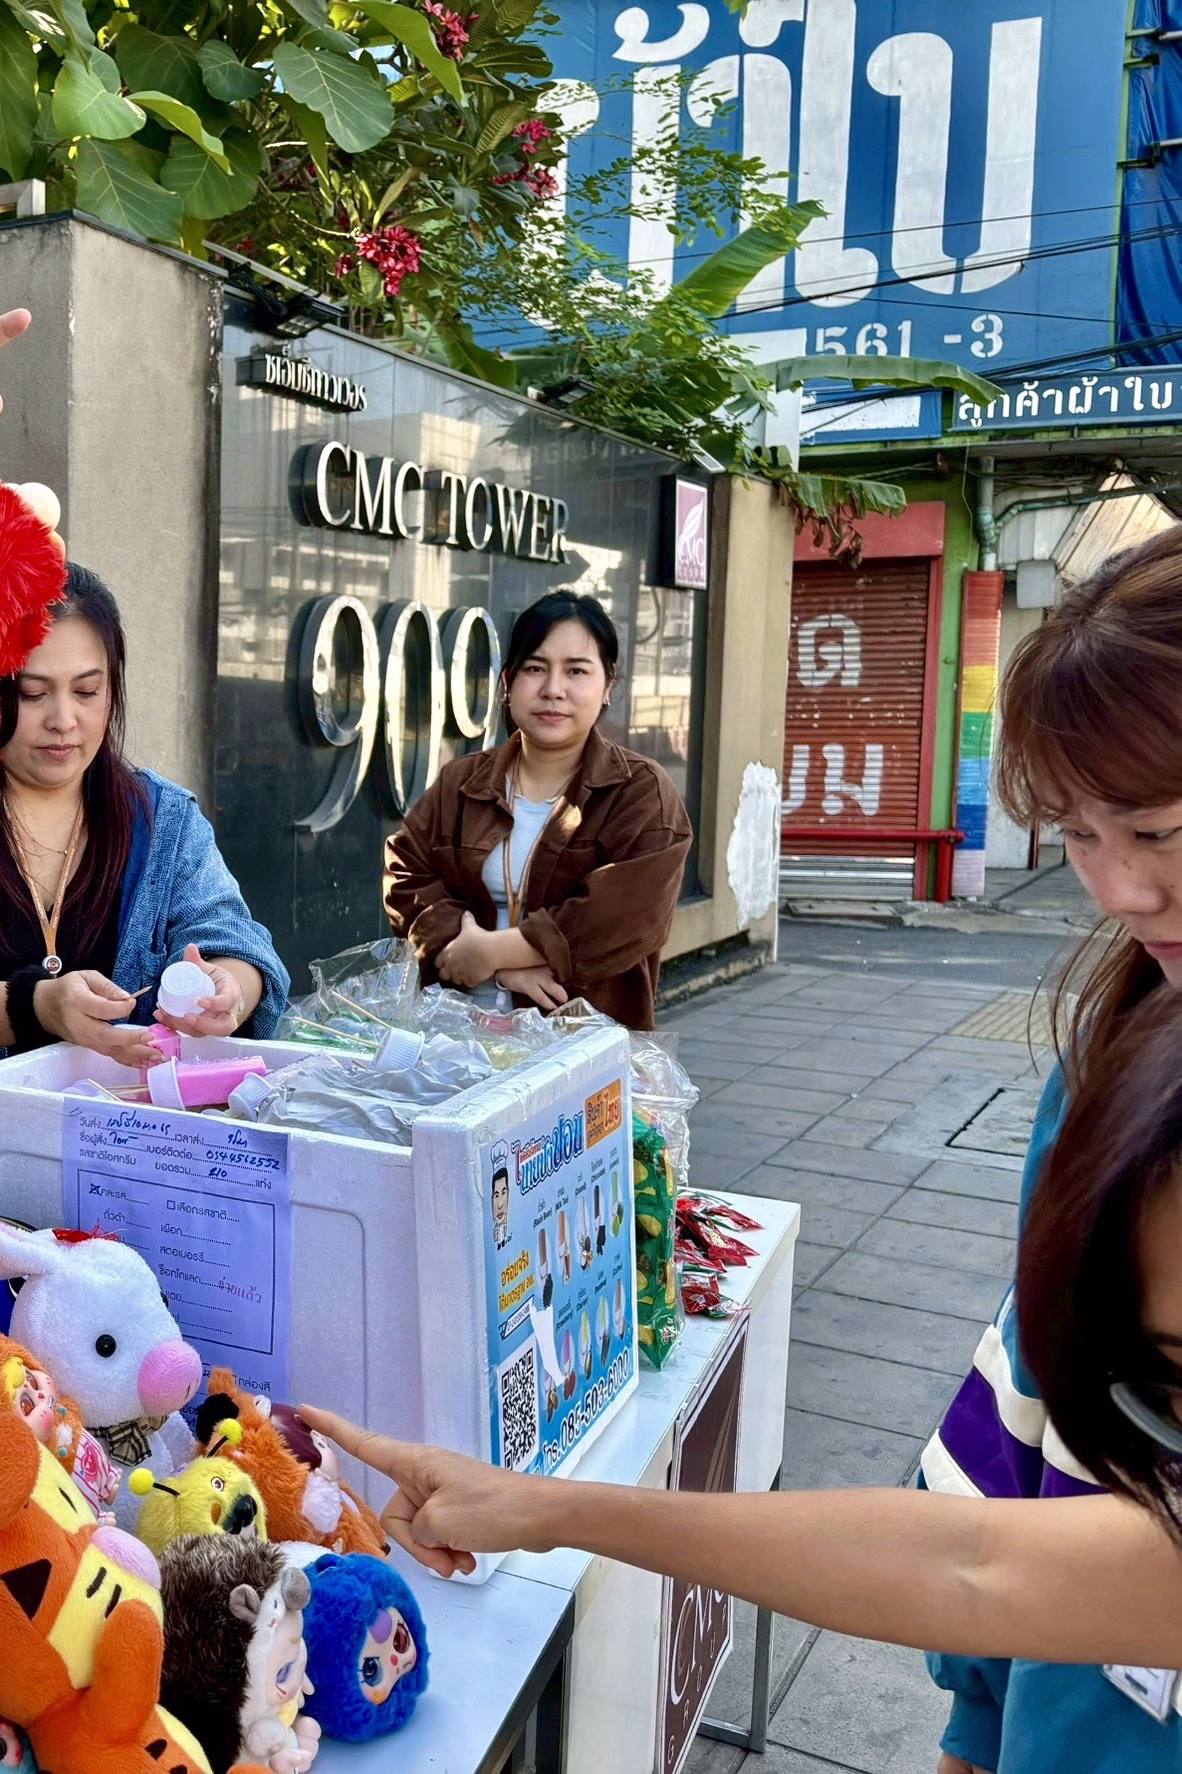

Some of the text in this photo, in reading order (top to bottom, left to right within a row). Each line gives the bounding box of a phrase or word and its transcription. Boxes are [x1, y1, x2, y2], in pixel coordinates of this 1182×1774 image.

[317, 441, 570, 565] CMC TOWER
[154, 1160, 191, 1176] ยอดรวม
[177, 1201, 227, 1221] เลือกรสชาติ
